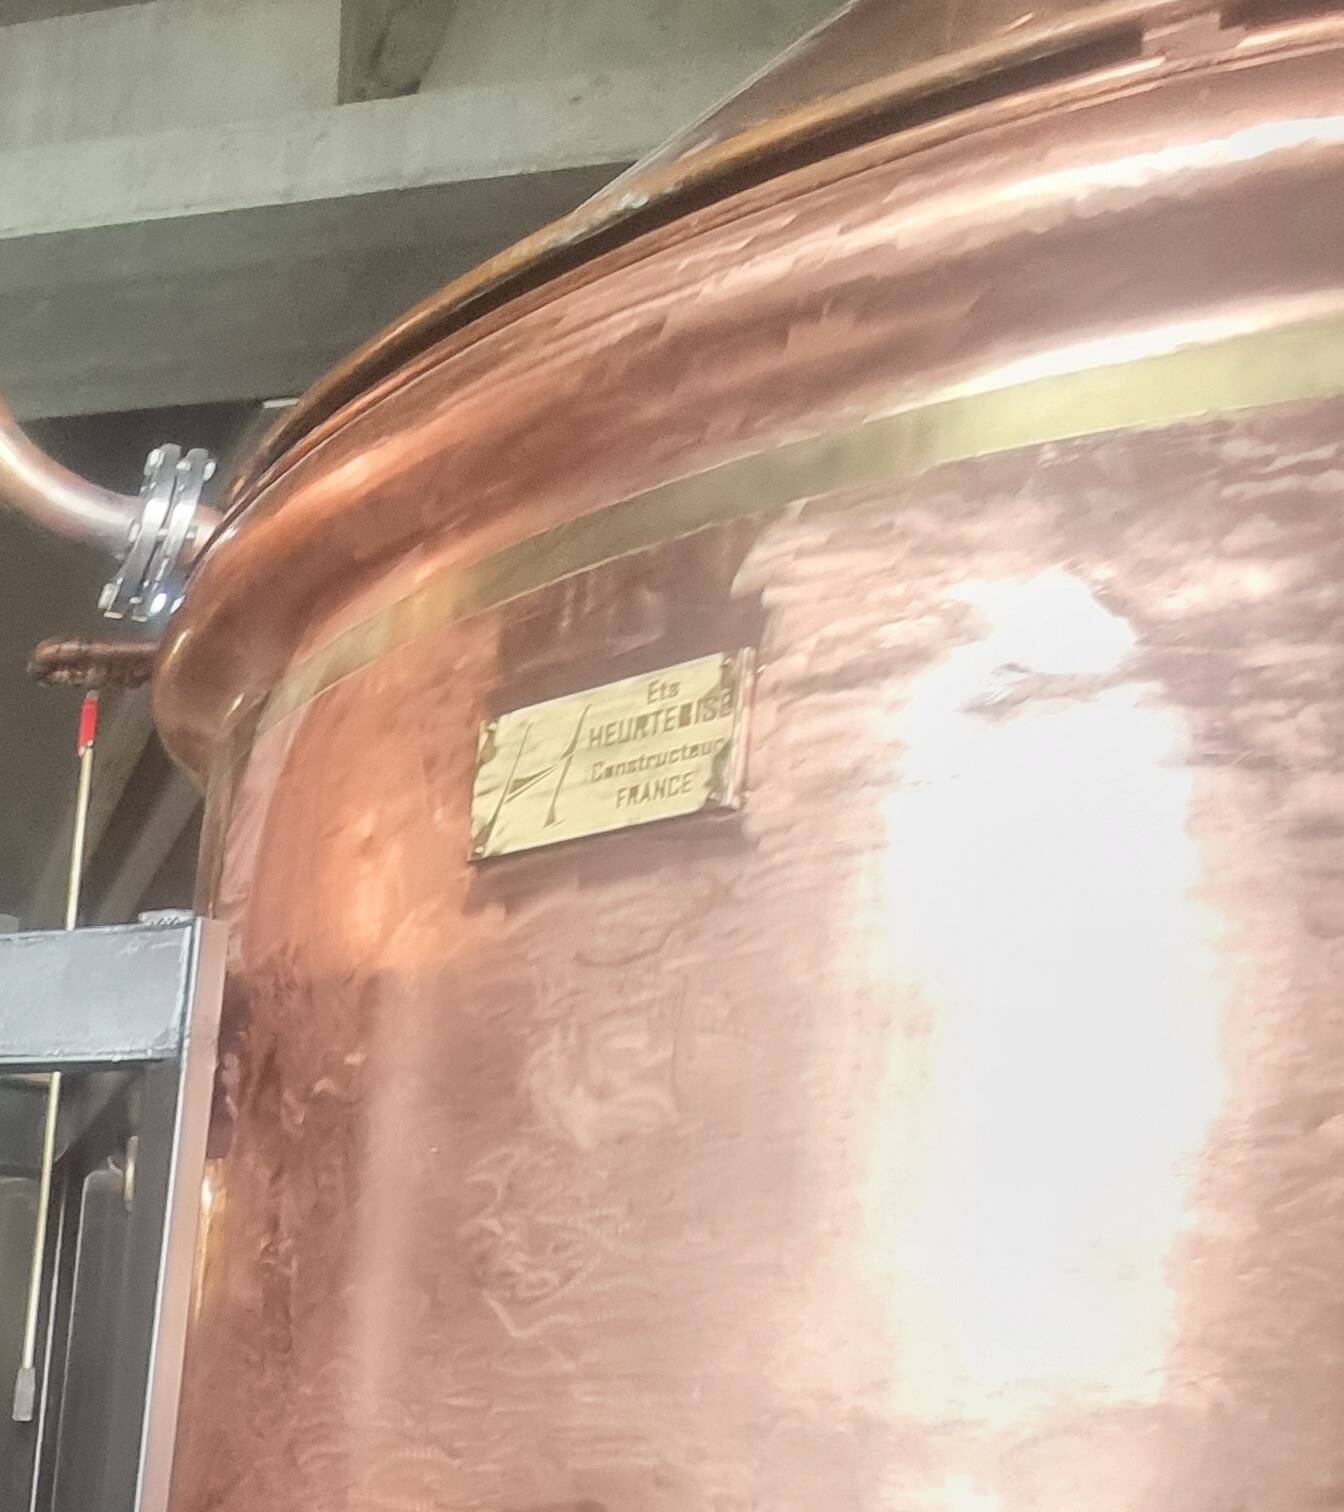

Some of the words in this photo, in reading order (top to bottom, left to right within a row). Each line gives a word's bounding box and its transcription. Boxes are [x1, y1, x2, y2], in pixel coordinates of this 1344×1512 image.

[647, 680, 680, 704] Ets
[592, 738, 724, 782] Constructeur
[615, 770, 695, 808] FRANCE
